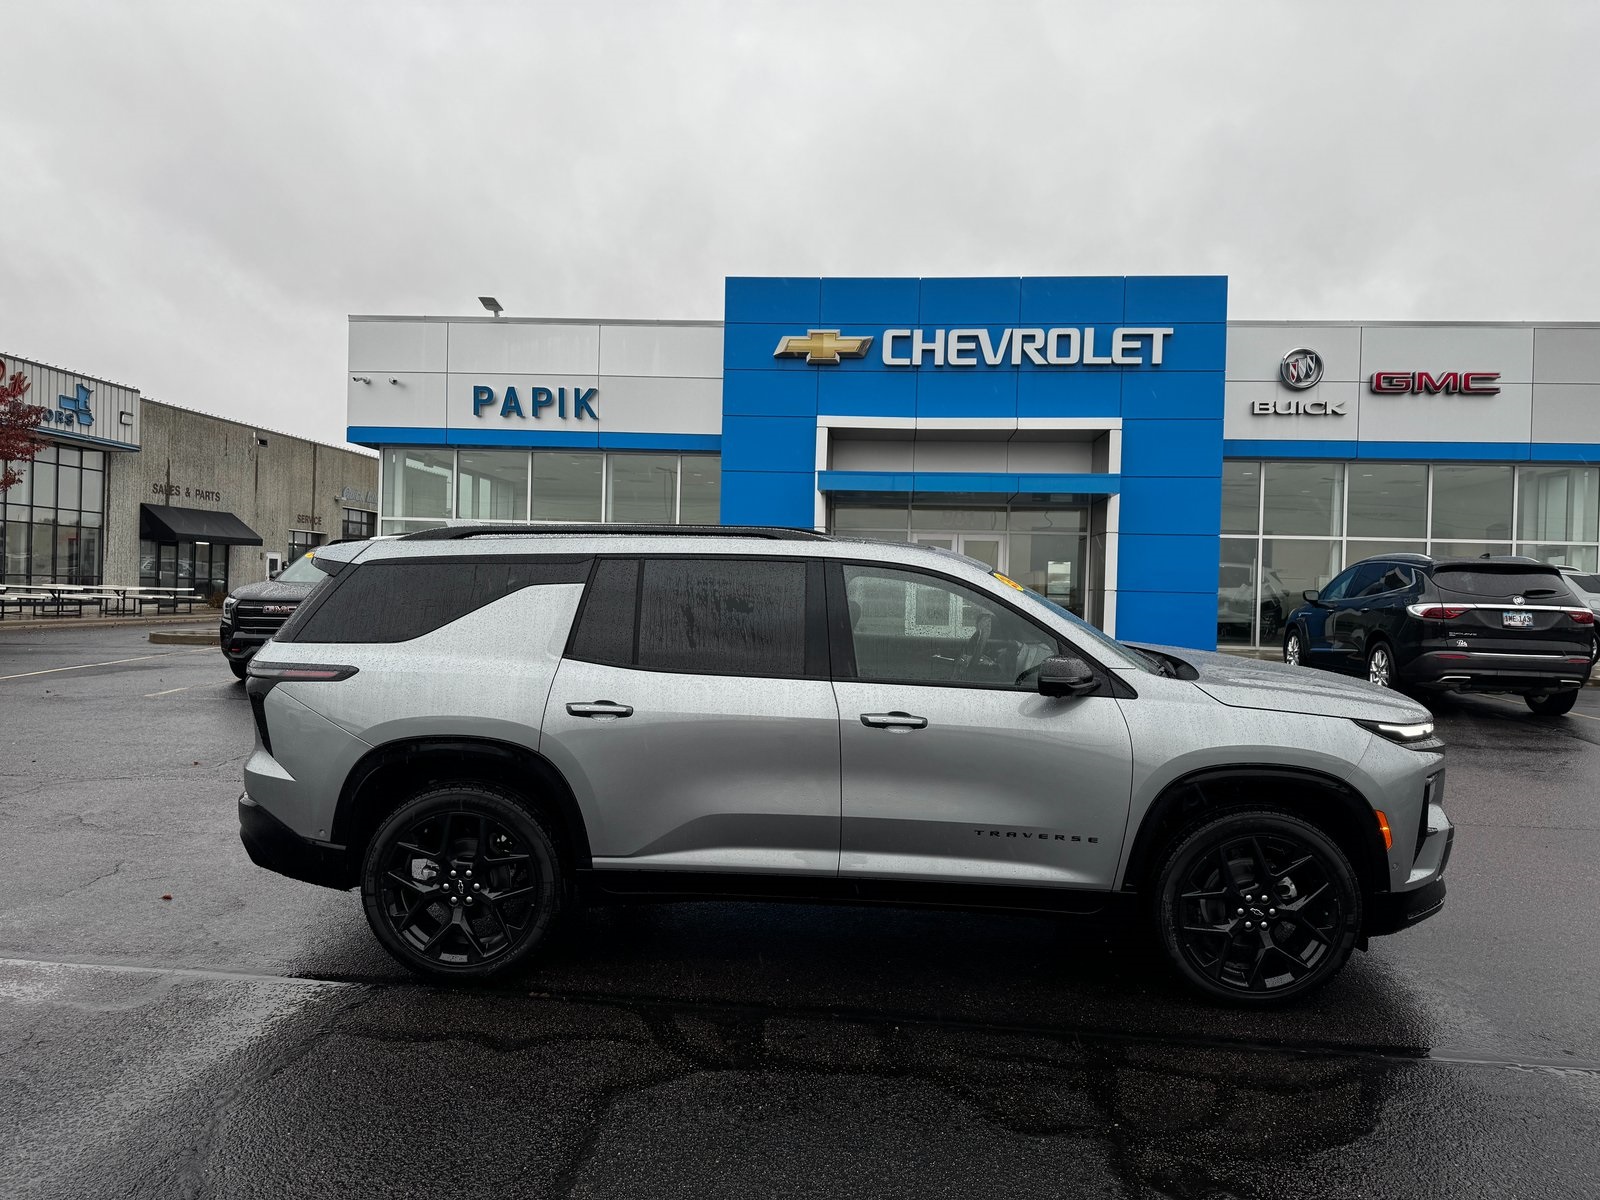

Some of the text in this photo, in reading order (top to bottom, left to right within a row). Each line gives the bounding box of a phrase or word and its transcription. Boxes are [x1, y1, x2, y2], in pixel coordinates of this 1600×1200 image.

[882, 327, 1174, 366] CHEVROLET
[1370, 371, 1501, 395] GMC
[473, 385, 599, 420] PAPIK
[1251, 400, 1347, 415] BUICK
[152, 483, 221, 502] SALES & PARTS
[297, 514, 322, 526] SERVICE
[974, 829, 1099, 844] TRAVERSE
